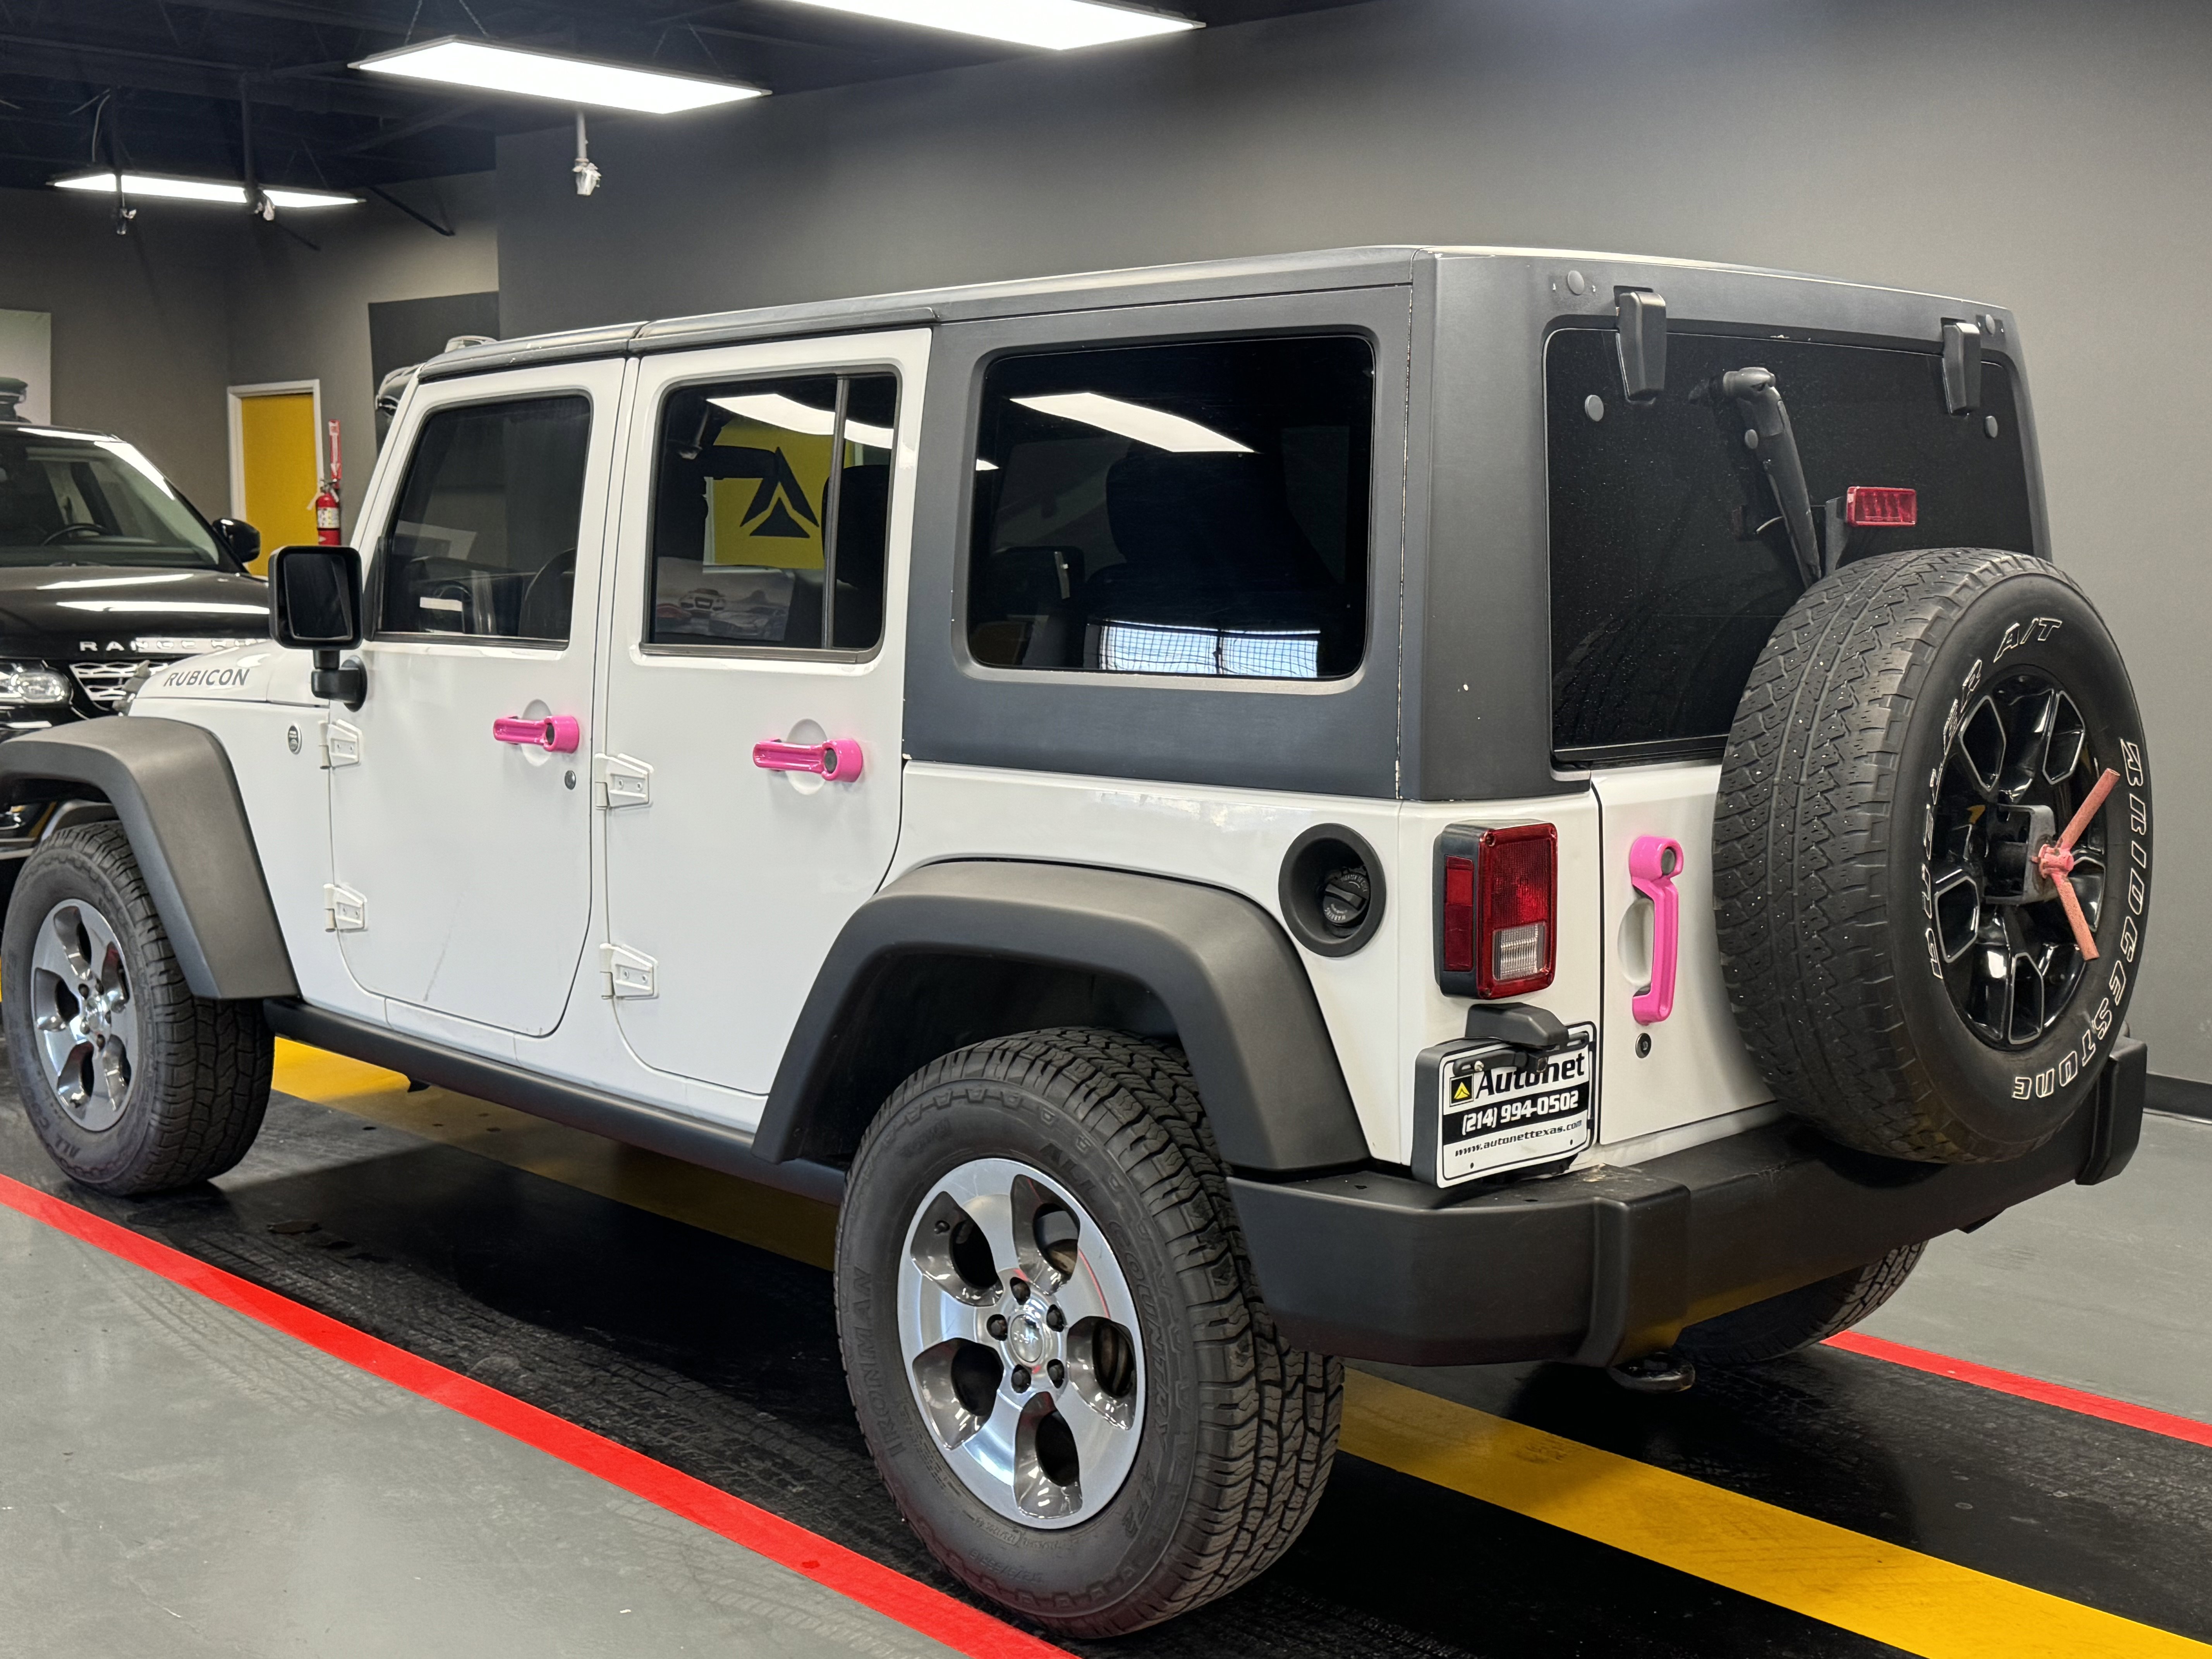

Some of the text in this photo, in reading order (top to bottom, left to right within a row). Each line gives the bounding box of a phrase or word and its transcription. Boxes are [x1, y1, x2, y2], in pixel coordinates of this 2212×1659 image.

[79, 640, 195, 651] RANGE
[1994, 617, 2062, 663] A/T
[164, 669, 250, 687] RUBICON
[2012, 738, 2147, 1100] BRIDGESTONE
[1475, 1053, 1585, 1099] Autonet
[1462, 1090, 1579, 1135] (214) 994-0502
[1455, 1120, 1582, 1156] www.autonettexas.com
[1108, 1221, 1168, 1450] COUNTRY
[853, 1266, 906, 1457] IRONMAN
